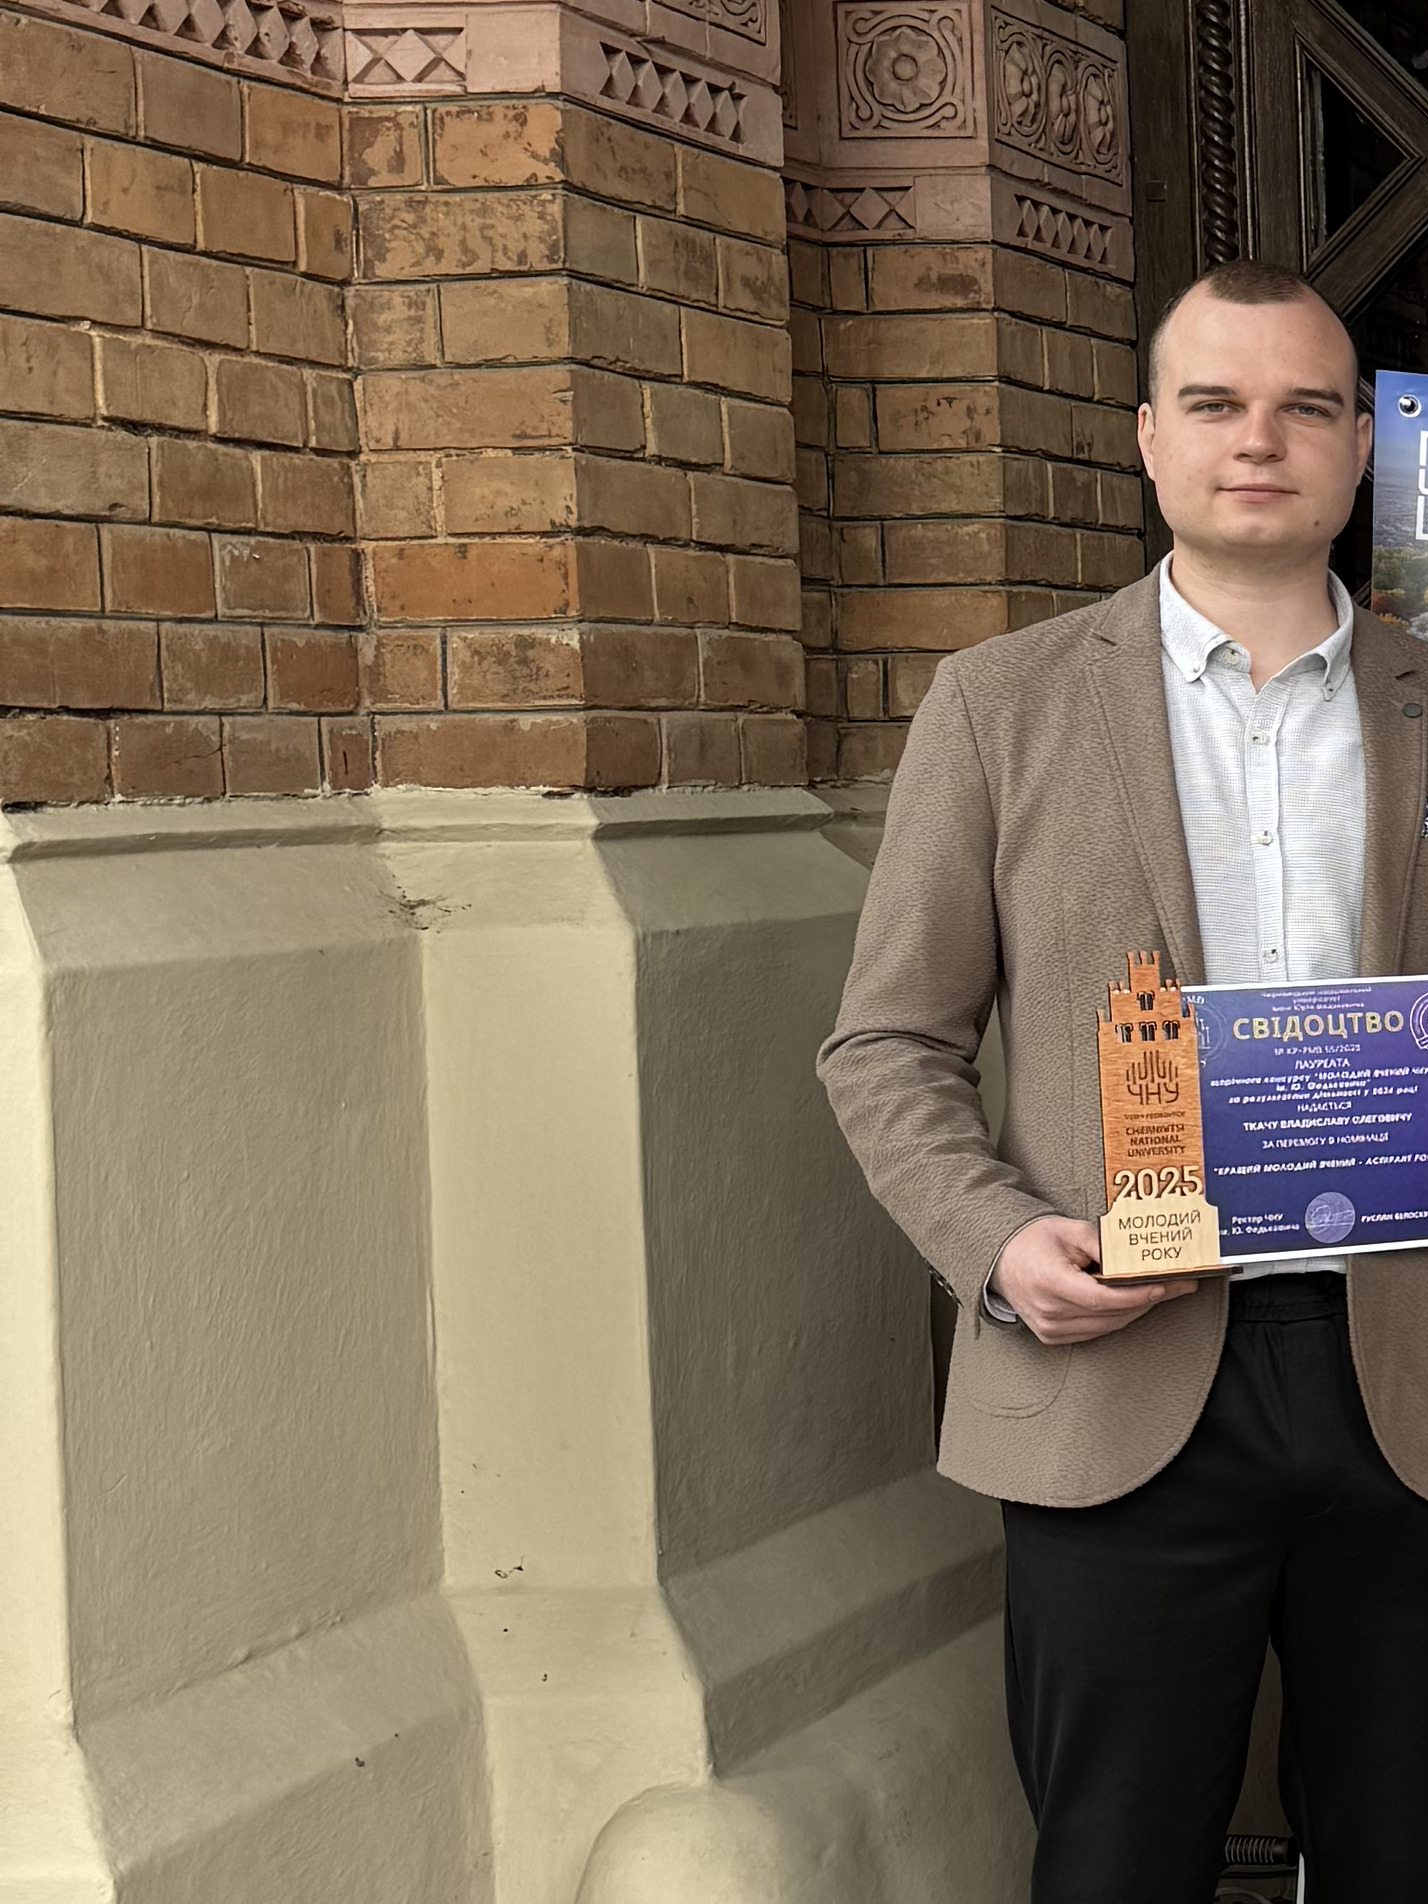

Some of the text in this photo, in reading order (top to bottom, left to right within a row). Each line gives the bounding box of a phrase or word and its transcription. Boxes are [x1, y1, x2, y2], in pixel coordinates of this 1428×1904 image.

[1232, 1010, 1404, 1042] СВІДОЦТВО
[1130, 1134, 1182, 1146] NATIONAL
[1114, 1164, 1203, 1199] 2025
[1118, 1209, 1201, 1230] МОЛОДИЙ
[1129, 1227, 1193, 1246] ВЧЕНИЙ
[1141, 1246, 1182, 1261] РОКУ
